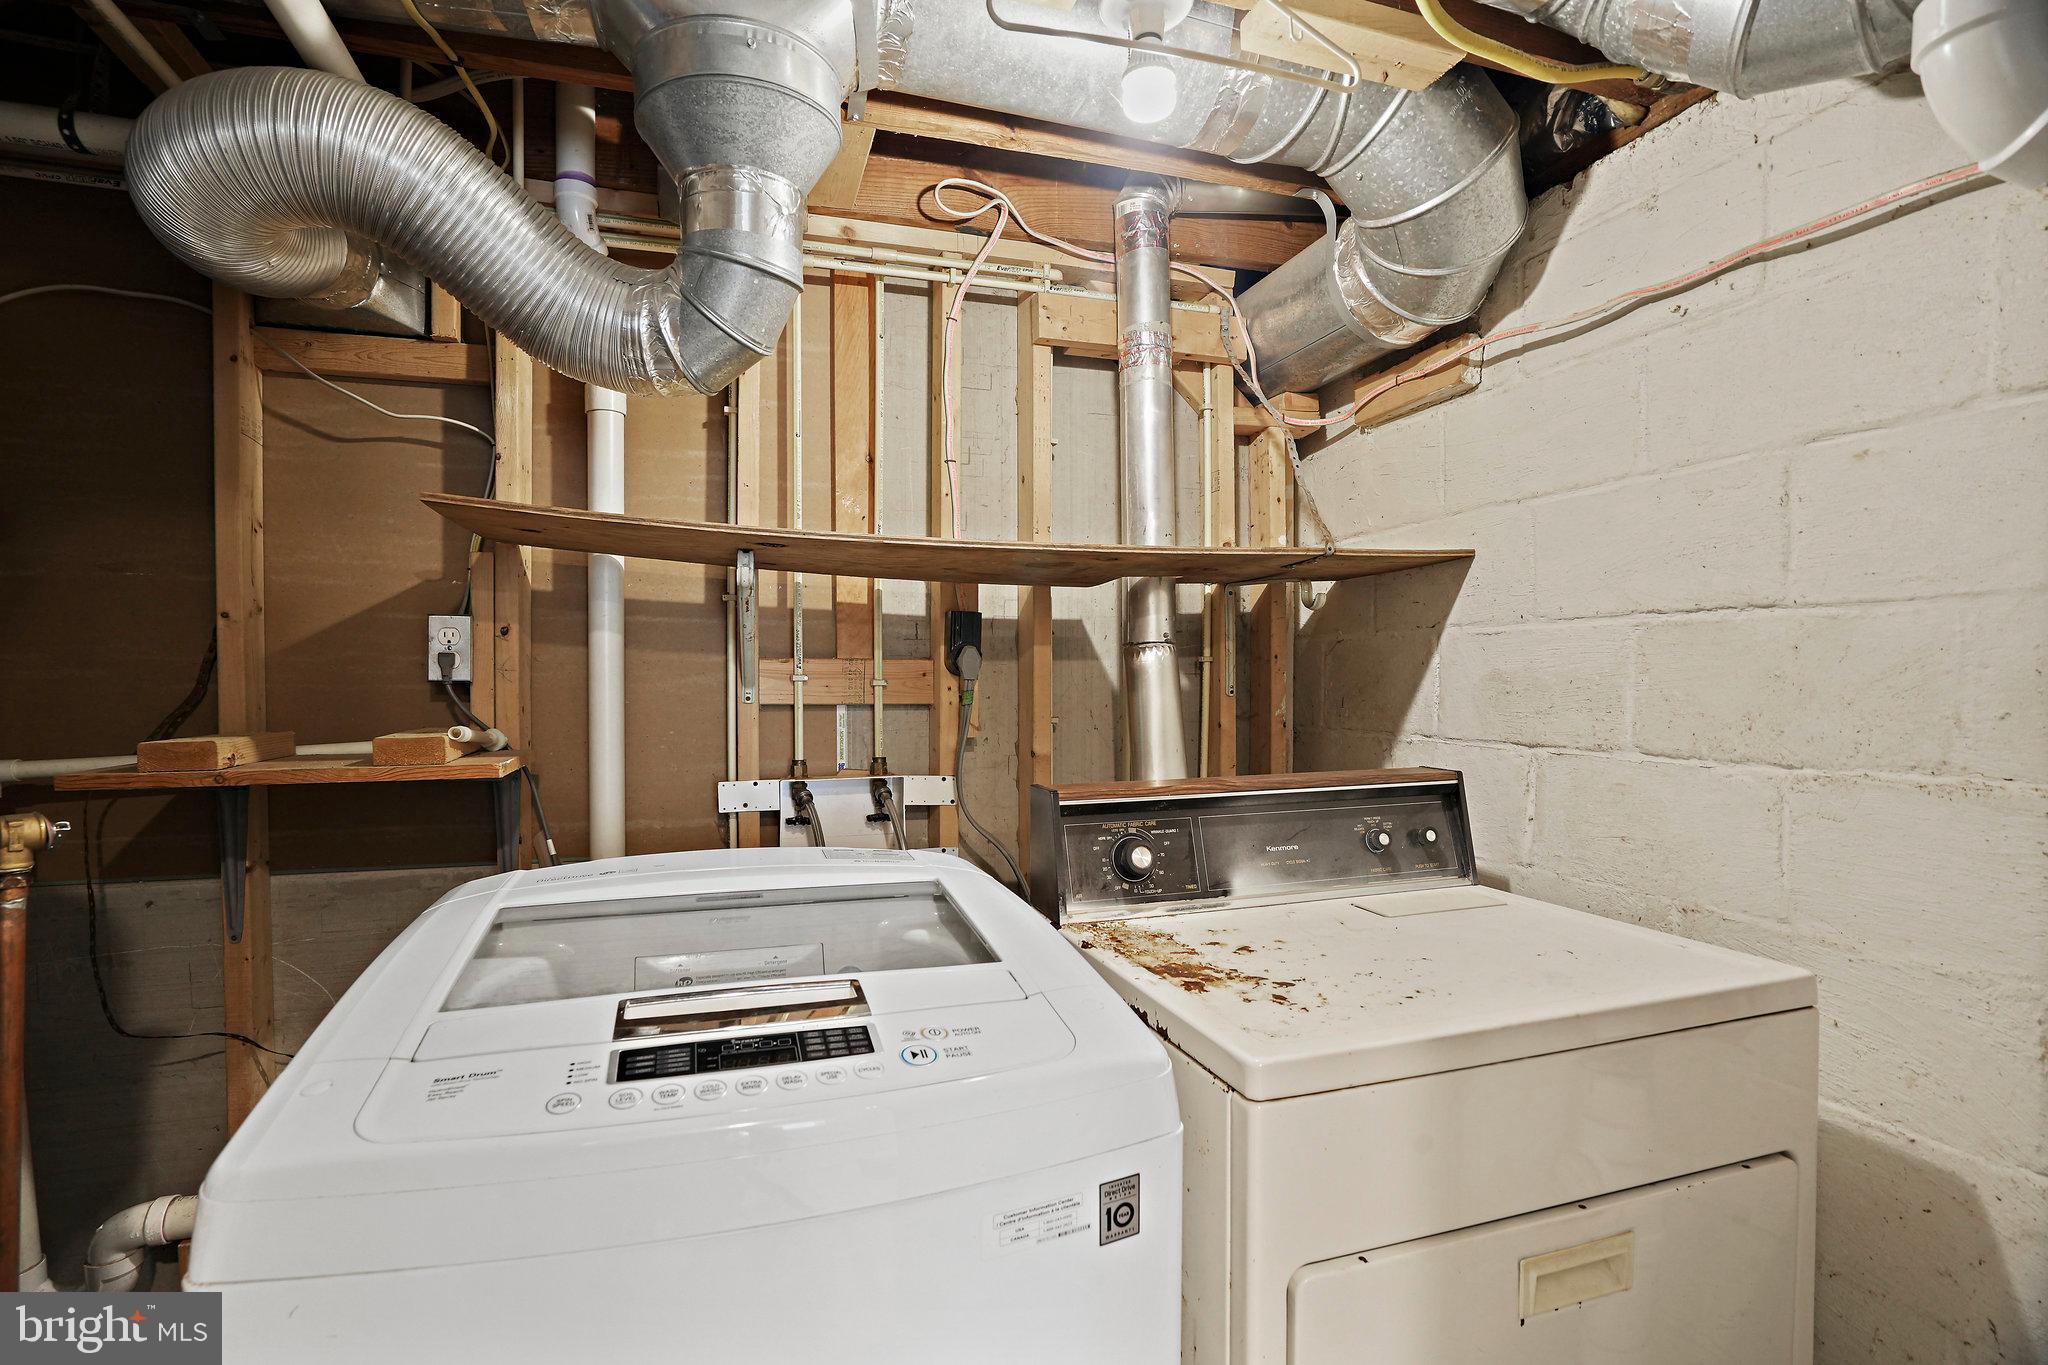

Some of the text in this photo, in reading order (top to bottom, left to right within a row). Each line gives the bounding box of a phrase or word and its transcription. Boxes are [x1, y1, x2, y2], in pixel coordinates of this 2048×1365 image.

[1265, 844, 1299, 852] Kenmore
[943, 1045, 969, 1054] START
[433, 1074, 465, 1084] Smart
[468, 1071, 497, 1079] Drum
[1104, 1184, 1136, 1198] Direct Drive
[1003, 1209, 1028, 1220] Customer
[1106, 1202, 1135, 1232] 10
[1118, 1211, 1129, 1219] YEAR
[1105, 1227, 1135, 1240] WARRANTY
